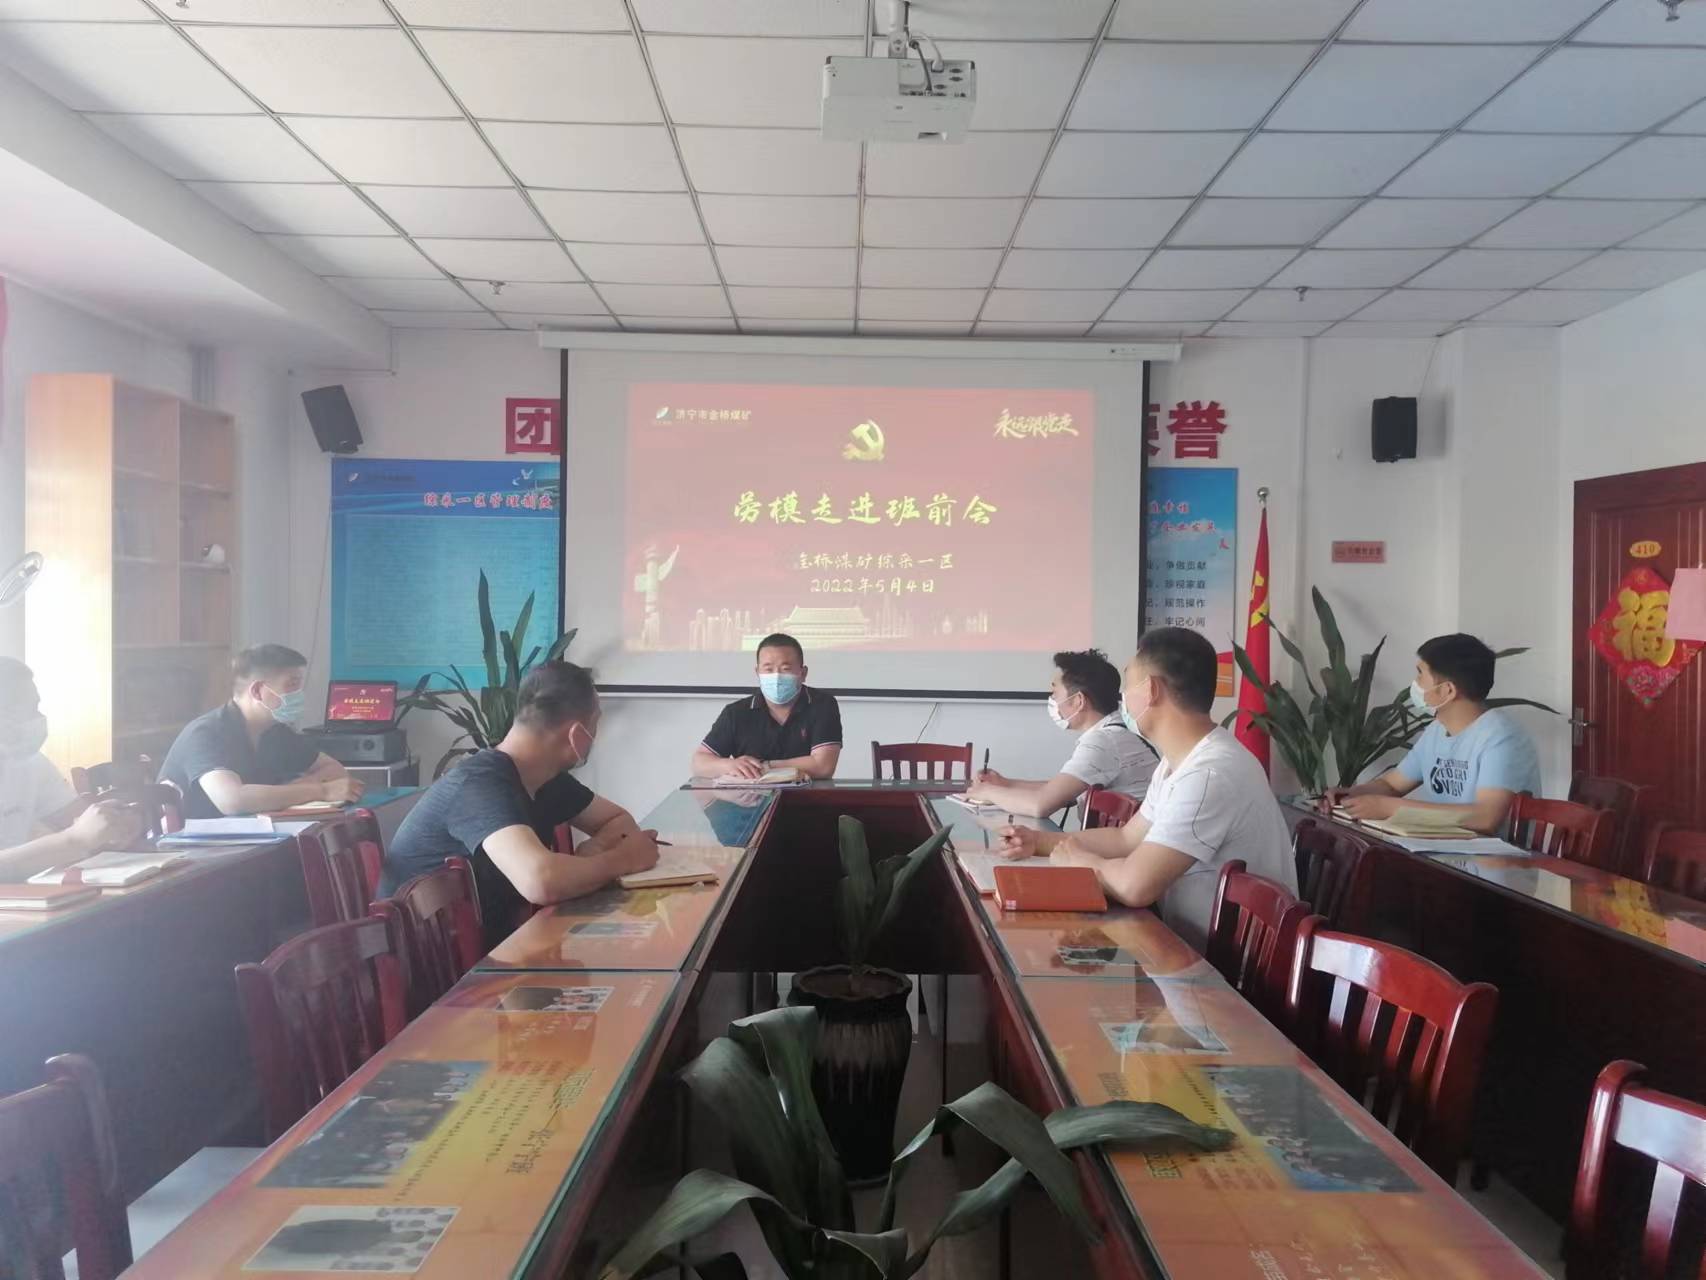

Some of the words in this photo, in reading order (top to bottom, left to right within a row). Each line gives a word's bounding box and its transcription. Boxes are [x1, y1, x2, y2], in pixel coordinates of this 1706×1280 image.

[506, 398, 561, 454] 团
[1148, 400, 1227, 459] 誉
[734, 491, 998, 526] 劳模走进班前会
[810, 577, 935, 596] 2022年5月4日
